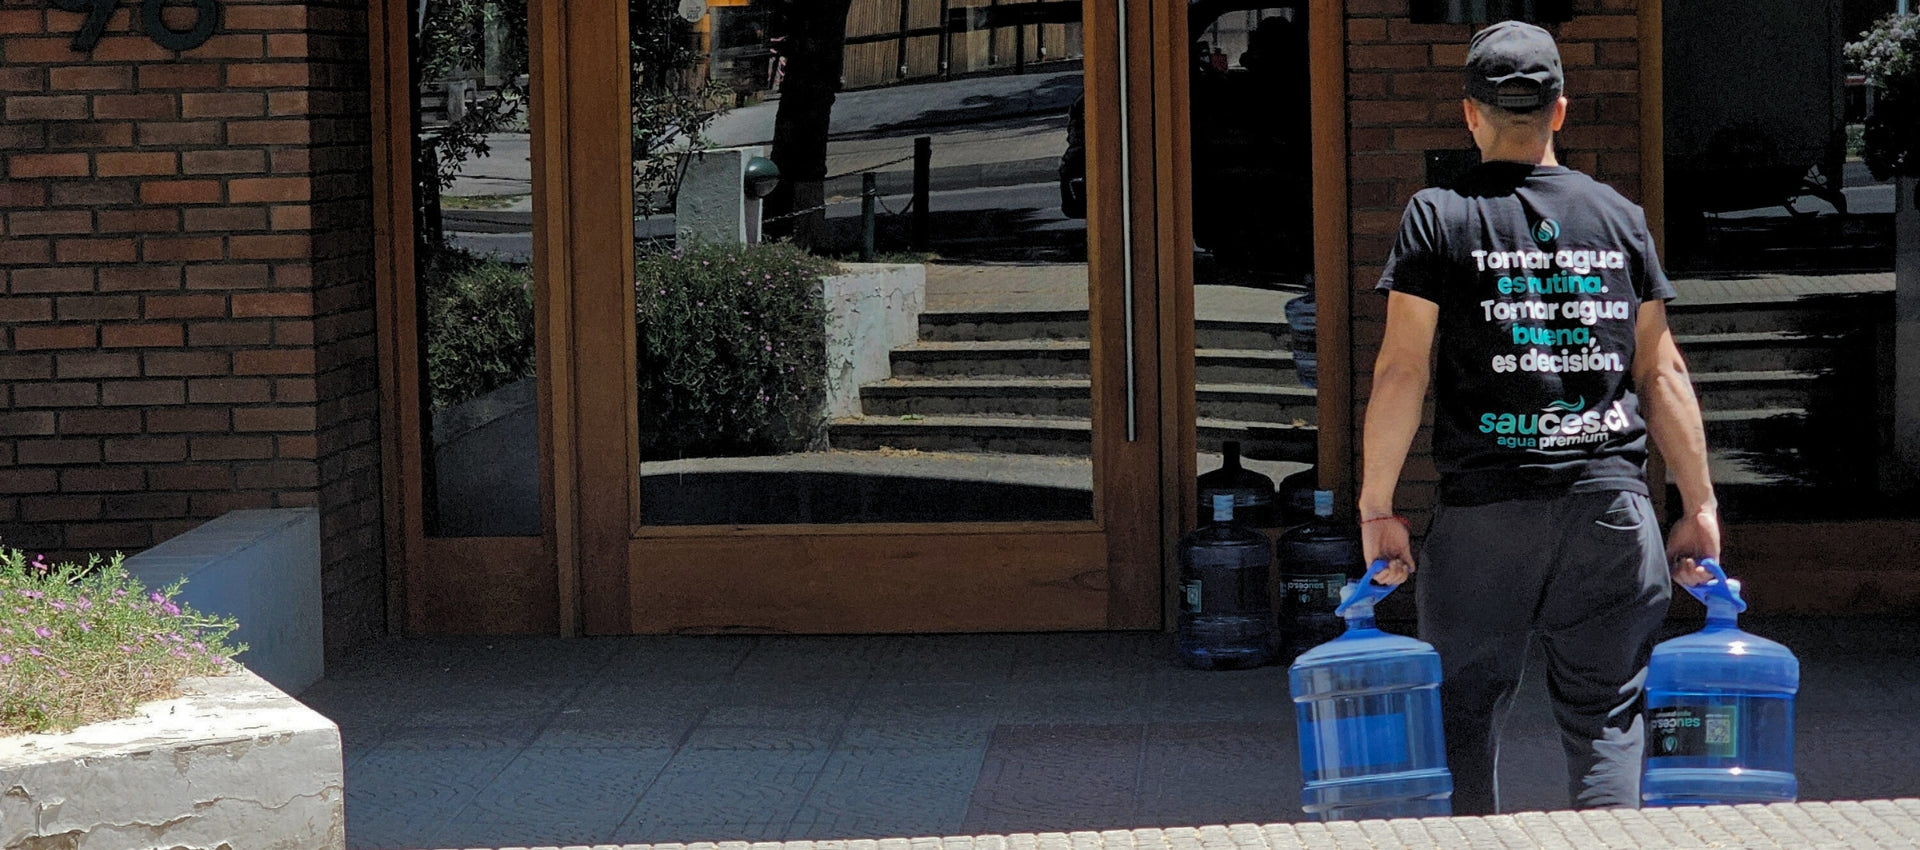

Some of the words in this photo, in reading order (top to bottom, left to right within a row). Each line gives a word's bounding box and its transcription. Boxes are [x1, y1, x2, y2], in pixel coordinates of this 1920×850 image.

[1471, 250, 1553, 271] Tomar
[1555, 250, 1625, 274] agua
[1497, 276, 1526, 294] es
[1527, 270, 1609, 294] rutina.
[1480, 300, 1559, 322] Tomar
[1561, 301, 1629, 325] agua
[1512, 323, 1597, 347] buena,
[1492, 354, 1517, 373] es
[1520, 346, 1624, 373] decisión.
[1479, 401, 1630, 435] sauces.cl
[1497, 435, 1536, 448] agua
[1539, 432, 1609, 449] premium
